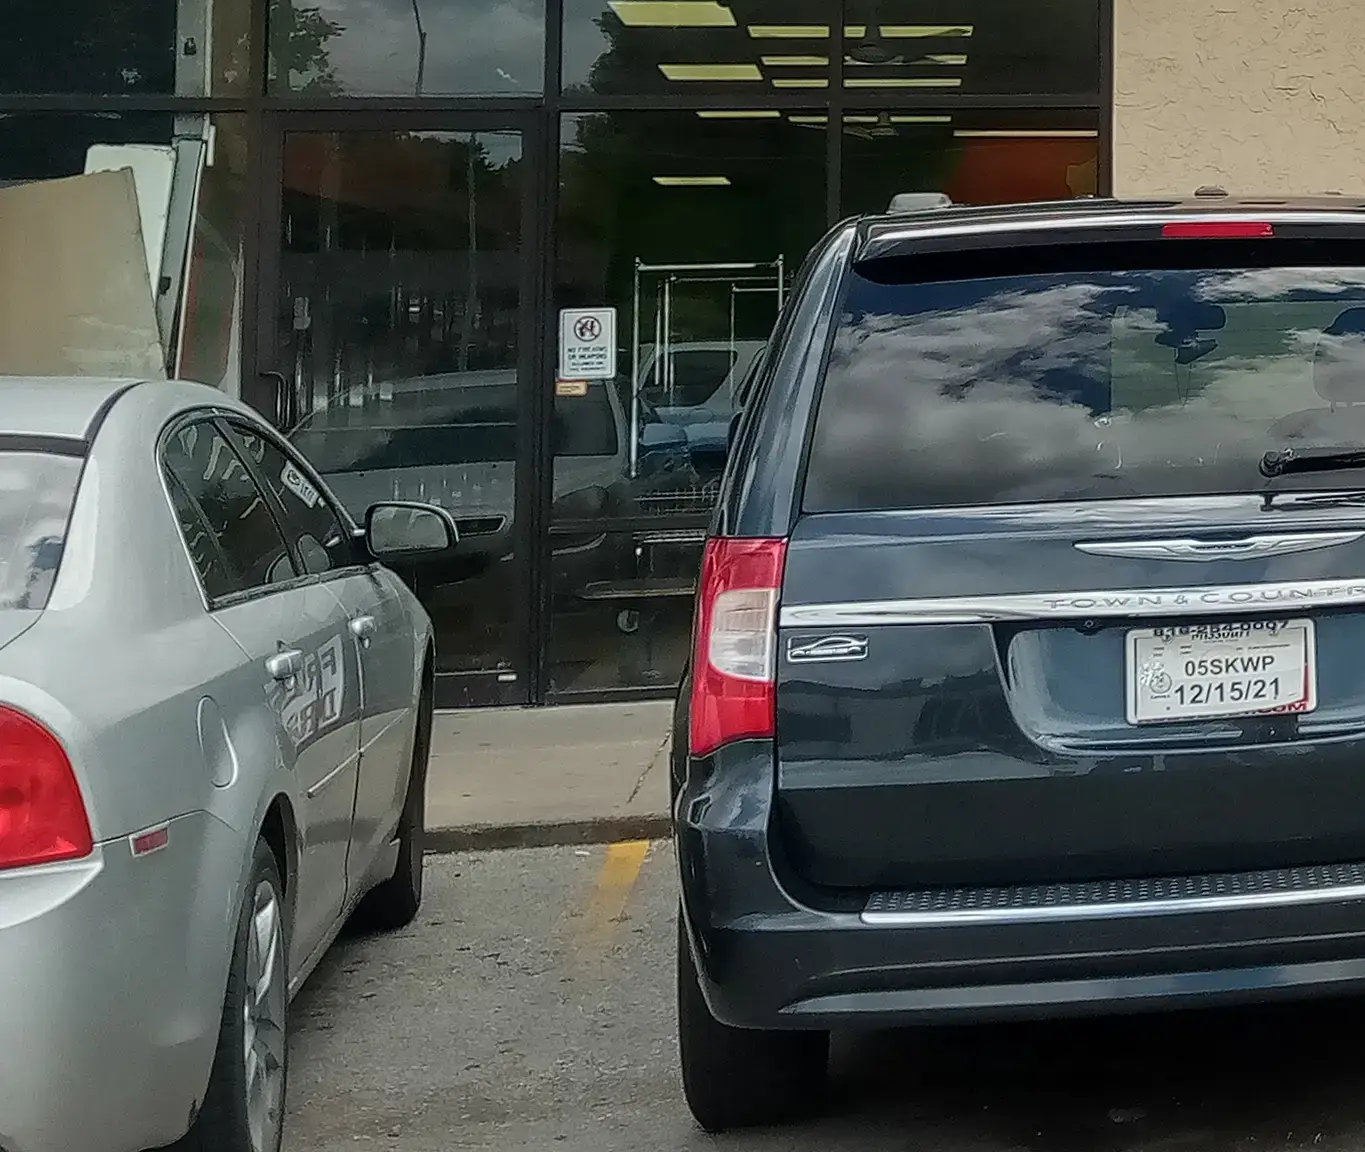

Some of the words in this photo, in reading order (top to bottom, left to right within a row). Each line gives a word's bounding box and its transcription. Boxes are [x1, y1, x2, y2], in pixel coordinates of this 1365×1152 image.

[1044, 596, 1162, 609] TOWN
[1174, 594, 1189, 605] &
[1184, 656, 1275, 677] 05SKWP
[1174, 677, 1280, 706] 12/15/21
